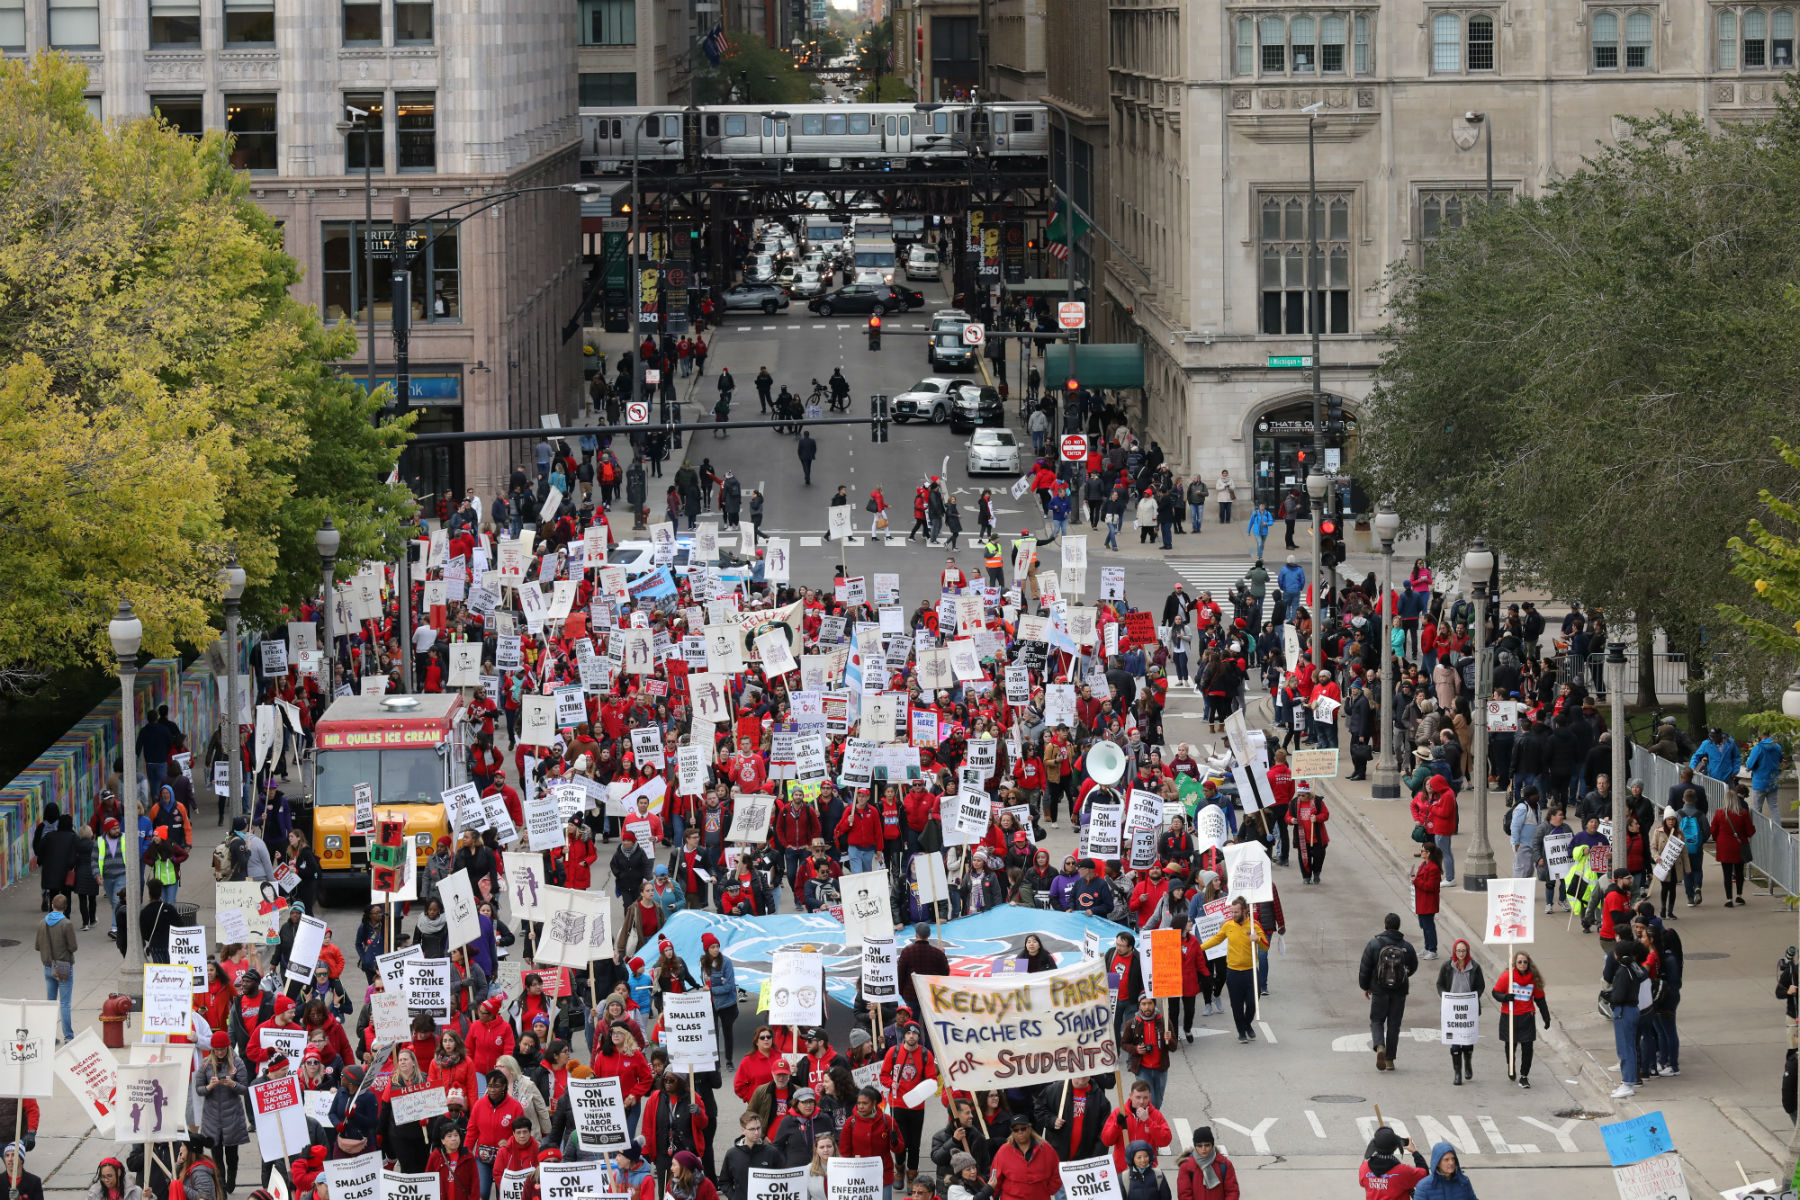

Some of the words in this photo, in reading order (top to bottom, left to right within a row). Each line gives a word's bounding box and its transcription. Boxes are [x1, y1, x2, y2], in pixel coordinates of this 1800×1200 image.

[980, 266, 999, 274] 250
[1274, 358, 1296, 366] Michigan
[742, 611, 779, 630] KELLY
[1125, 612, 1150, 621] MAYOR
[565, 694, 575, 702] ON
[560, 704, 583, 713] STRIKE
[325, 734, 343, 745] MR.
[346, 733, 383, 745] QUILES
[385, 733, 402, 744] ICE
[404, 731, 441, 743] CREAM
[913, 739, 937, 747] CARE
[637, 745, 659, 753] STRIKE
[978, 747, 988, 755] ON
[970, 756, 994, 765] STRIKE
[455, 793, 467, 801] ON
[969, 795, 981, 806] ON
[1142, 799, 1154, 808] ON
[532, 810, 554, 818] PARENTS
[961, 805, 987, 820] STRIKE
[1134, 803, 1159, 816] STRIKE
[529, 814, 558, 824] EDUCATORS
[1093, 819, 1117, 827] STRIKE
[1134, 814, 1155, 824] BETTER
[532, 821, 557, 829] STUDENTS
[375, 847, 388, 862] H
[378, 872, 391, 889] S
[856, 904, 859, 912] I
[857, 908, 879, 918] School
[171, 945, 200, 954] STRIKE
[868, 947, 881, 955] ON
[865, 955, 890, 963] STRIKE
[930, 984, 1032, 1022] KELVYN
[1050, 972, 1108, 1006] PARK
[149, 1011, 186, 1027] TEACH!
[934, 1020, 1042, 1044] TEACHERS
[1054, 1006, 1110, 1035] STAND
[1078, 1028, 1107, 1045] UP
[26, 1042, 36, 1050] MY
[276, 1040, 290, 1048] ON
[11, 1050, 38, 1061] School
[949, 1052, 983, 1081] FOR
[995, 1040, 1117, 1078] STUDENTS
[85, 1069, 107, 1085] PARENTS
[86, 1068, 97, 1078] AND
[91, 1075, 108, 1089] UNITED
[267, 1079, 292, 1090] SUPPORT
[264, 1087, 288, 1098] CHICAGO
[401, 1082, 431, 1094] HELLO
[584, 1089, 602, 1097] ON
[263, 1094, 291, 1104] TEACHERS
[277, 1099, 293, 1109] STAFF
[577, 1098, 616, 1108] STRIKE
[1356, 1115, 1583, 1154] ONLY
[335, 1173, 376, 1188] SMALLER
[560, 1176, 580, 1186] ON
[1077, 1173, 1095, 1184] ON
[399, 1185, 418, 1194] ON
[550, 1186, 593, 1198] STRIKE
[769, 1183, 788, 1193] ON
[831, 1185, 879, 1193] ENFERMERA
[1071, 1181, 1111, 1196] STRIKE
[344, 1188, 373, 1200] CLASS
